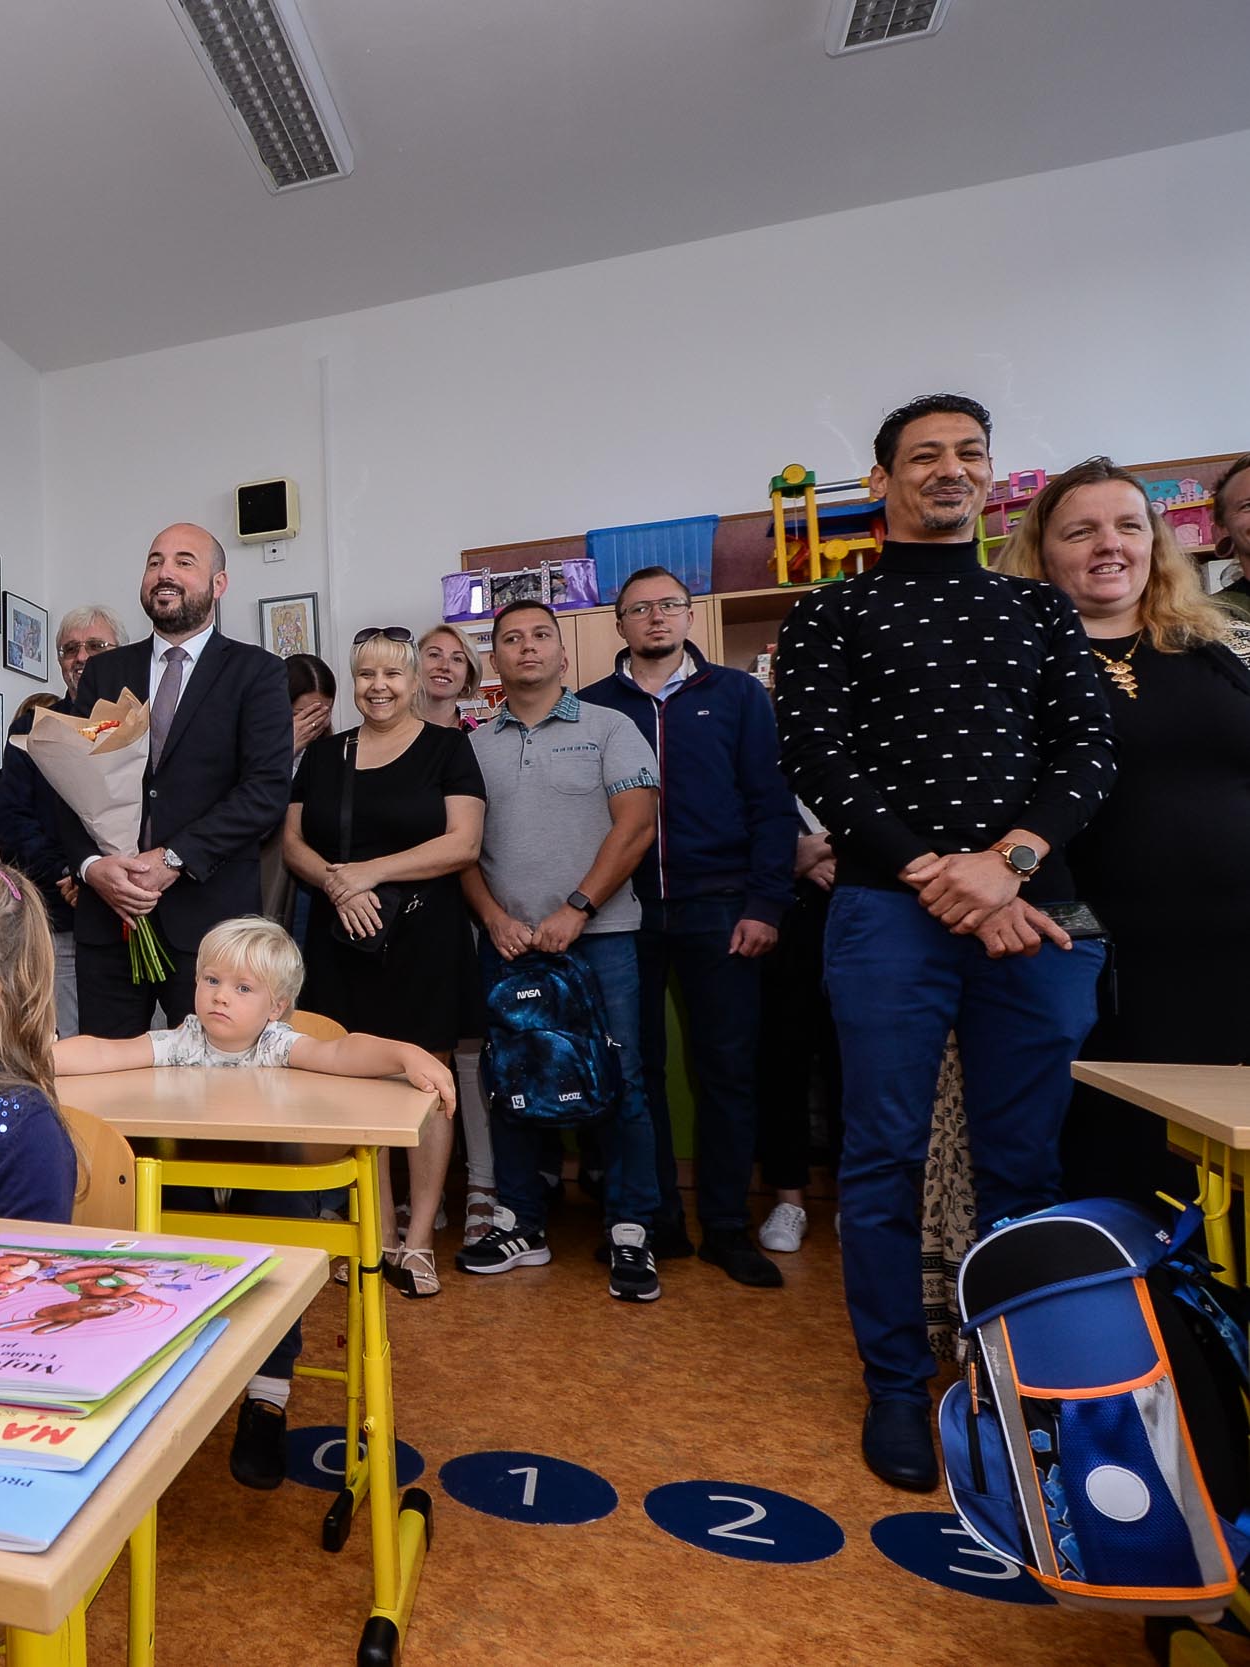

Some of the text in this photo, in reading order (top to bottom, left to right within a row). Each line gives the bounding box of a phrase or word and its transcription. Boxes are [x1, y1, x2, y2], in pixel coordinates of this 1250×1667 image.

[517, 989, 541, 999] NASA
[508, 1467, 538, 1506] 1
[708, 1495, 775, 1545] 2
[940, 1528, 1021, 1580] 3
